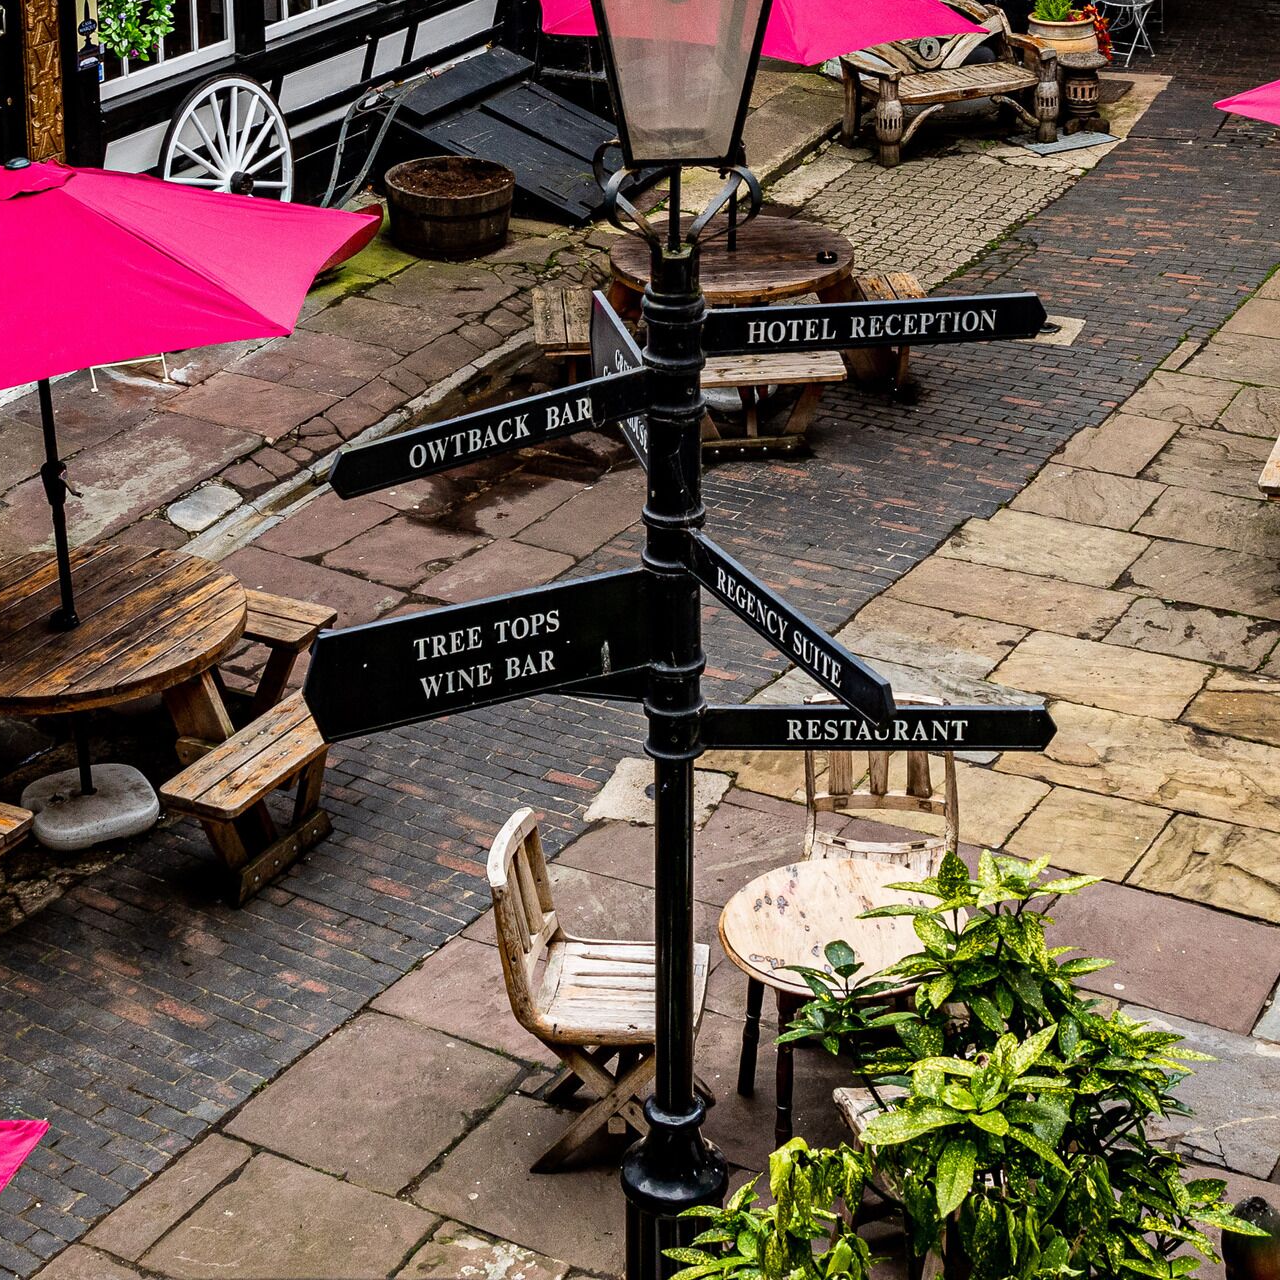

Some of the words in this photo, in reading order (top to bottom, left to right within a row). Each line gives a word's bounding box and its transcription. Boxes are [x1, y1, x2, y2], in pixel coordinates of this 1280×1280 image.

[747, 318, 837, 344] HOTEL
[849, 309, 997, 339] RECEPTION
[409, 413, 531, 469] OWTBACK
[545, 398, 592, 431] BAR
[413, 626, 483, 661] TREE
[494, 609, 560, 644] TOPS
[716, 567, 789, 643] REGENCY
[792, 630, 842, 688] SUITE
[419, 662, 493, 700] WINE
[505, 650, 555, 681] BAR
[786, 720, 968, 741] RESTAURANT
